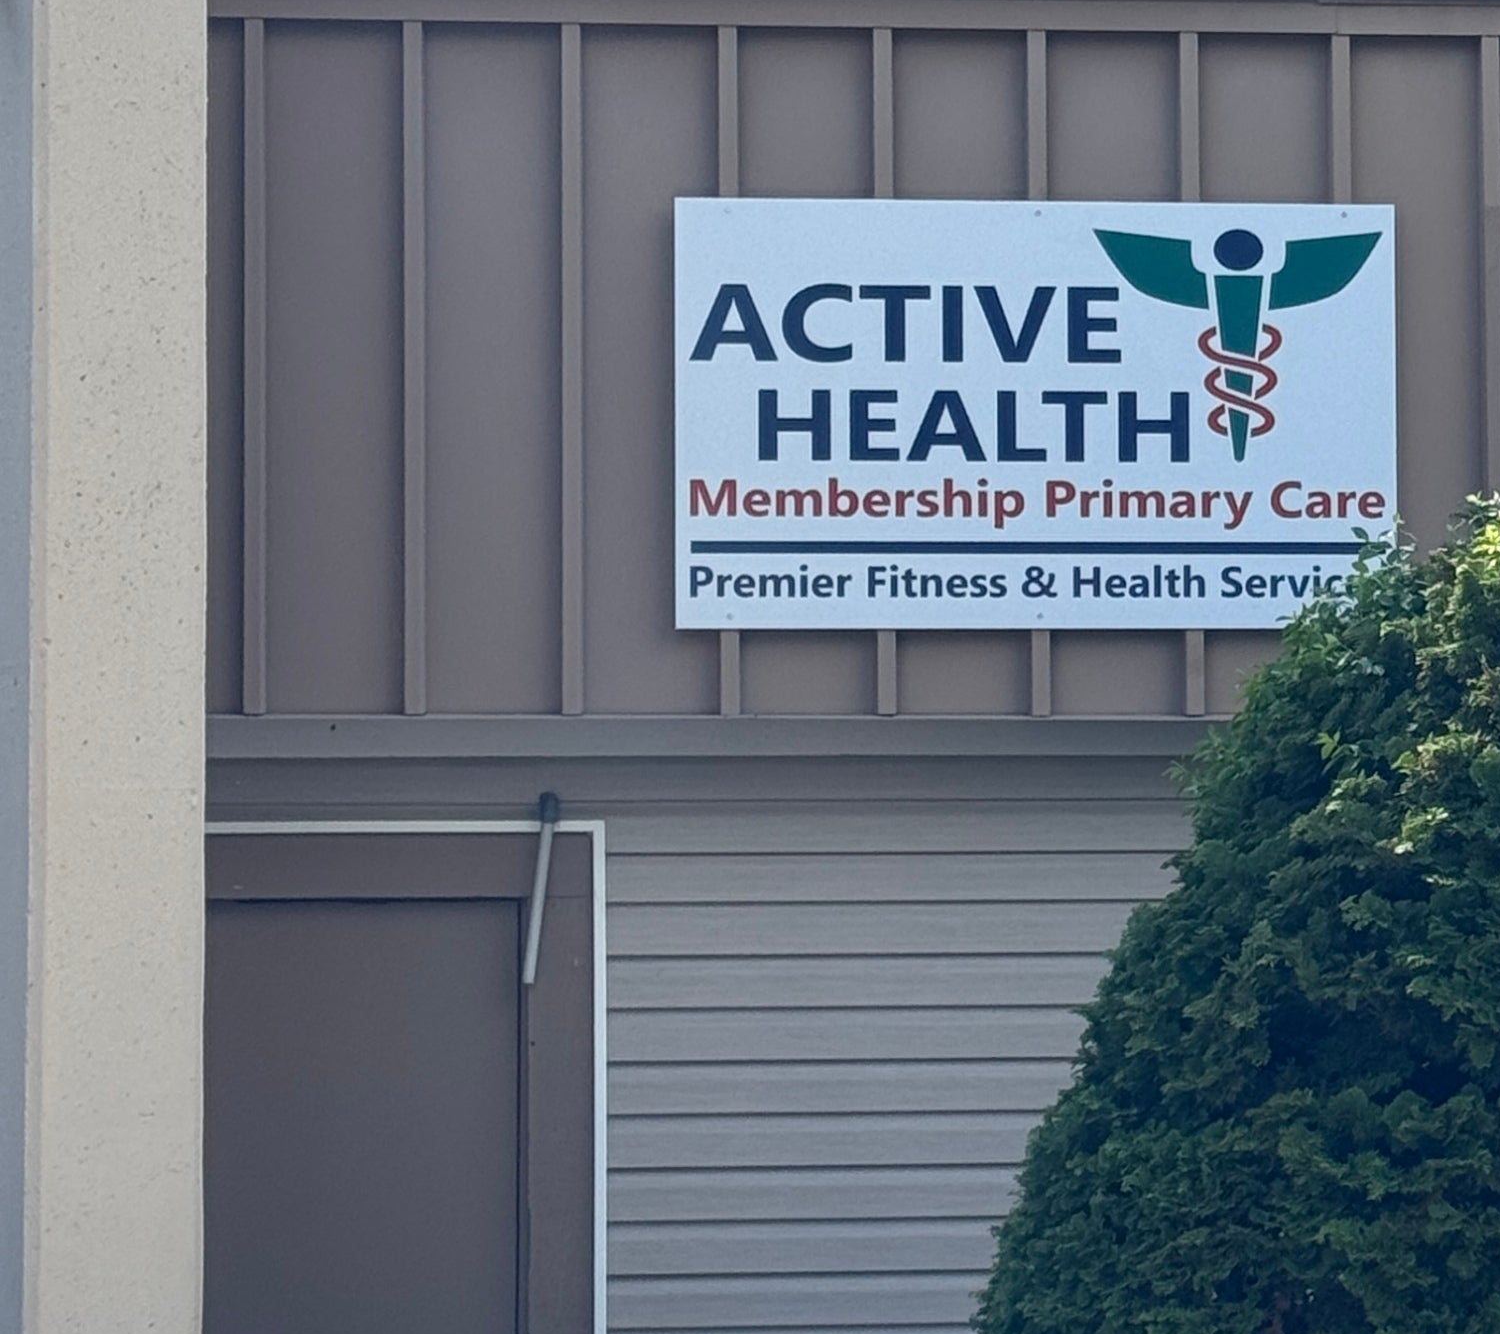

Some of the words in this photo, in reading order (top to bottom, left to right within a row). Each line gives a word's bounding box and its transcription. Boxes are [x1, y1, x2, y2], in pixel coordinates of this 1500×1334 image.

[690, 282, 1122, 364] ACTIVE
[758, 389, 1190, 463] HEALTH
[689, 478, 1025, 529] Membership
[1045, 479, 1254, 530] Primary
[1270, 481, 1386, 519] Care
[689, 565, 852, 598] Premier
[867, 565, 1008, 598] Fitness
[1021, 565, 1058, 598] &
[1072, 565, 1206, 598] Health
[1220, 565, 1354, 599] Servic
